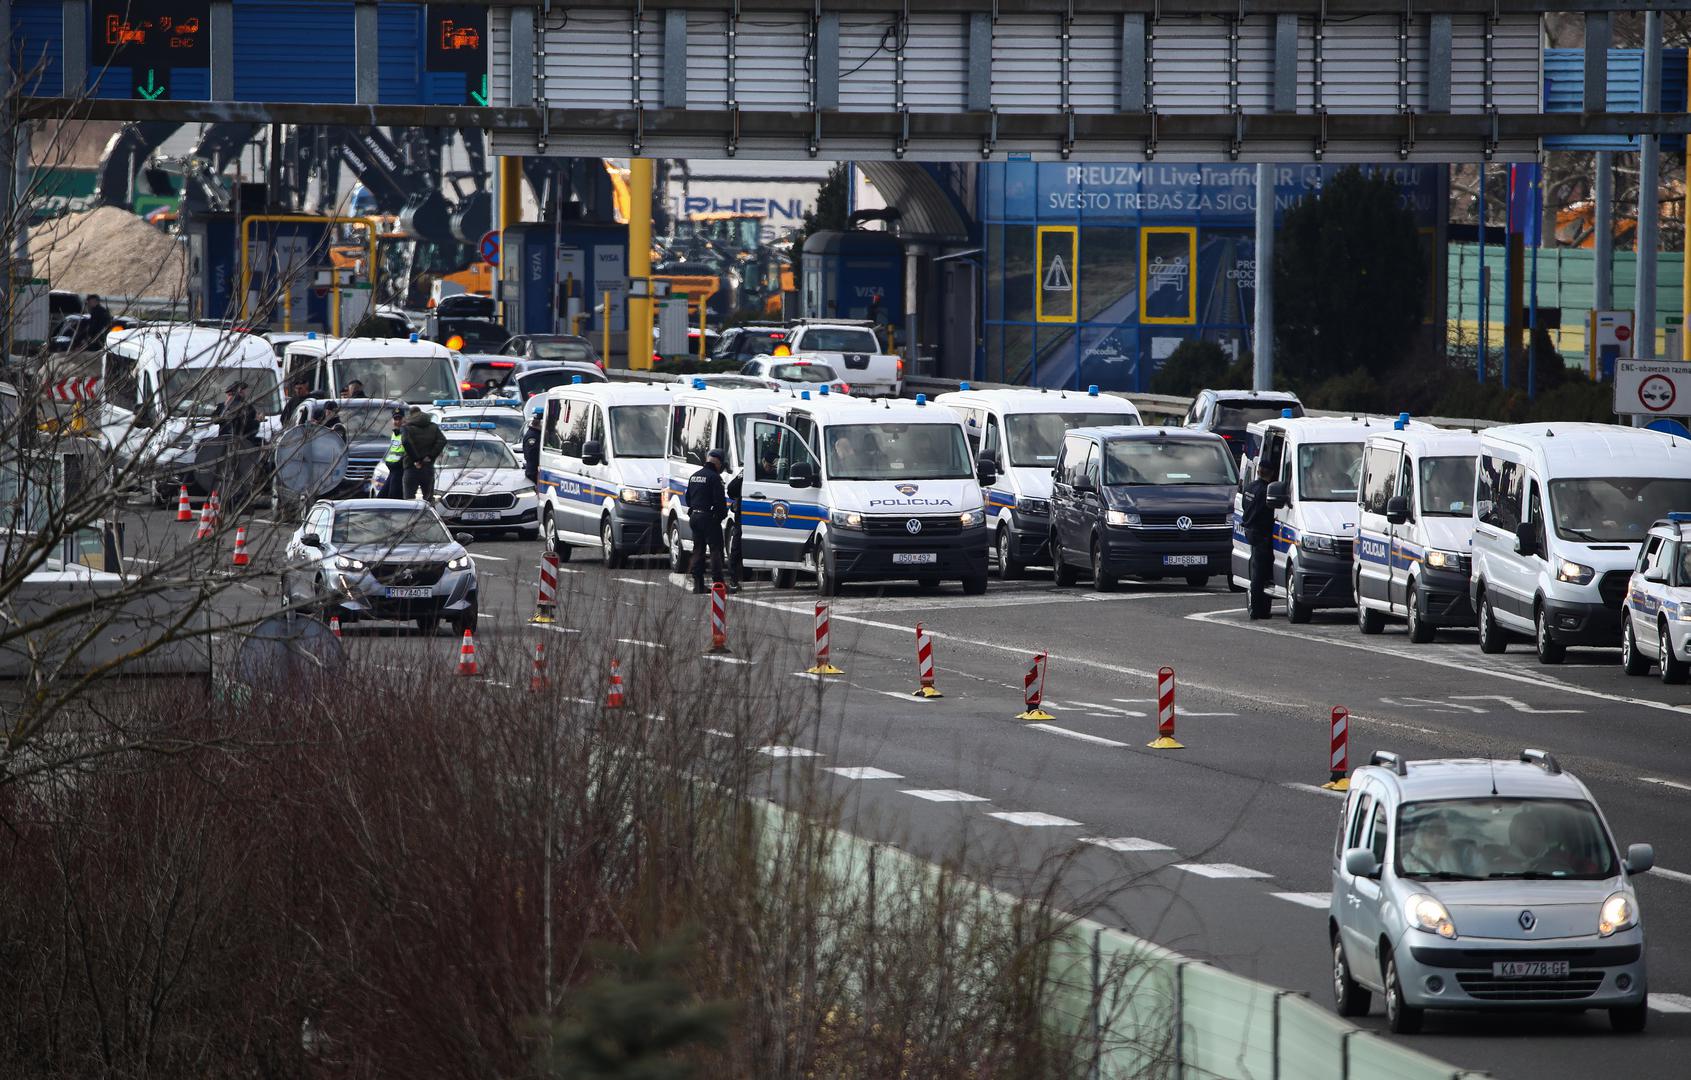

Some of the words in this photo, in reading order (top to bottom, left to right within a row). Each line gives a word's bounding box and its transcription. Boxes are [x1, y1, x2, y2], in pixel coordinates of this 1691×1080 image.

[170, 38, 193, 47] ENC
[342, 144, 367, 172] YUNDAI
[1066, 166, 1153, 185] PREUZMI
[1114, 190, 1183, 210] TREBAŠ
[1187, 194, 1212, 210] ZA
[684, 197, 803, 219] RHENI
[600, 254, 619, 262] VISA
[1236, 260, 1255, 269] PRO
[532, 252, 542, 281] VISA
[1226, 270, 1255, 279] CROC
[1237, 280, 1255, 288] CRO
[853, 286, 885, 297] VISA
[561, 480, 580, 495] POLICIJA
[870, 499, 952, 507] POLICIJA
[1363, 540, 1385, 558] POLICIJA
[1502, 962, 1516, 976] KA
[1525, 962, 1568, 976] 778-GE
